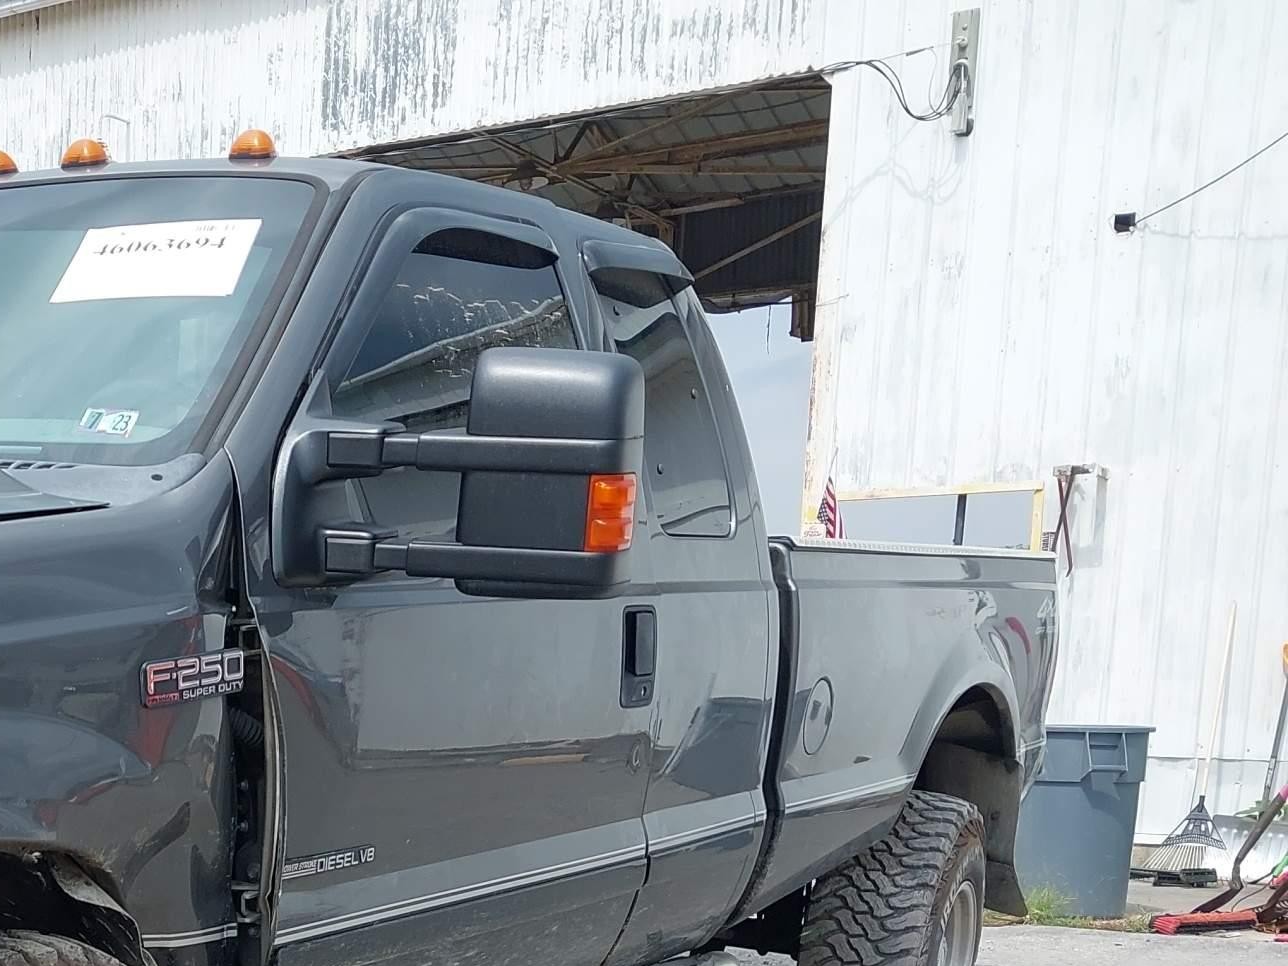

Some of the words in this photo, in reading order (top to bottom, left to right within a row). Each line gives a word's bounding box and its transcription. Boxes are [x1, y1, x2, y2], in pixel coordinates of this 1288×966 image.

[111, 413, 132, 432] 23
[182, 684, 217, 700] SUPER
[217, 679, 244, 693] DUTY
[316, 850, 359, 873] DIESEL
[359, 847, 376, 863] V8
